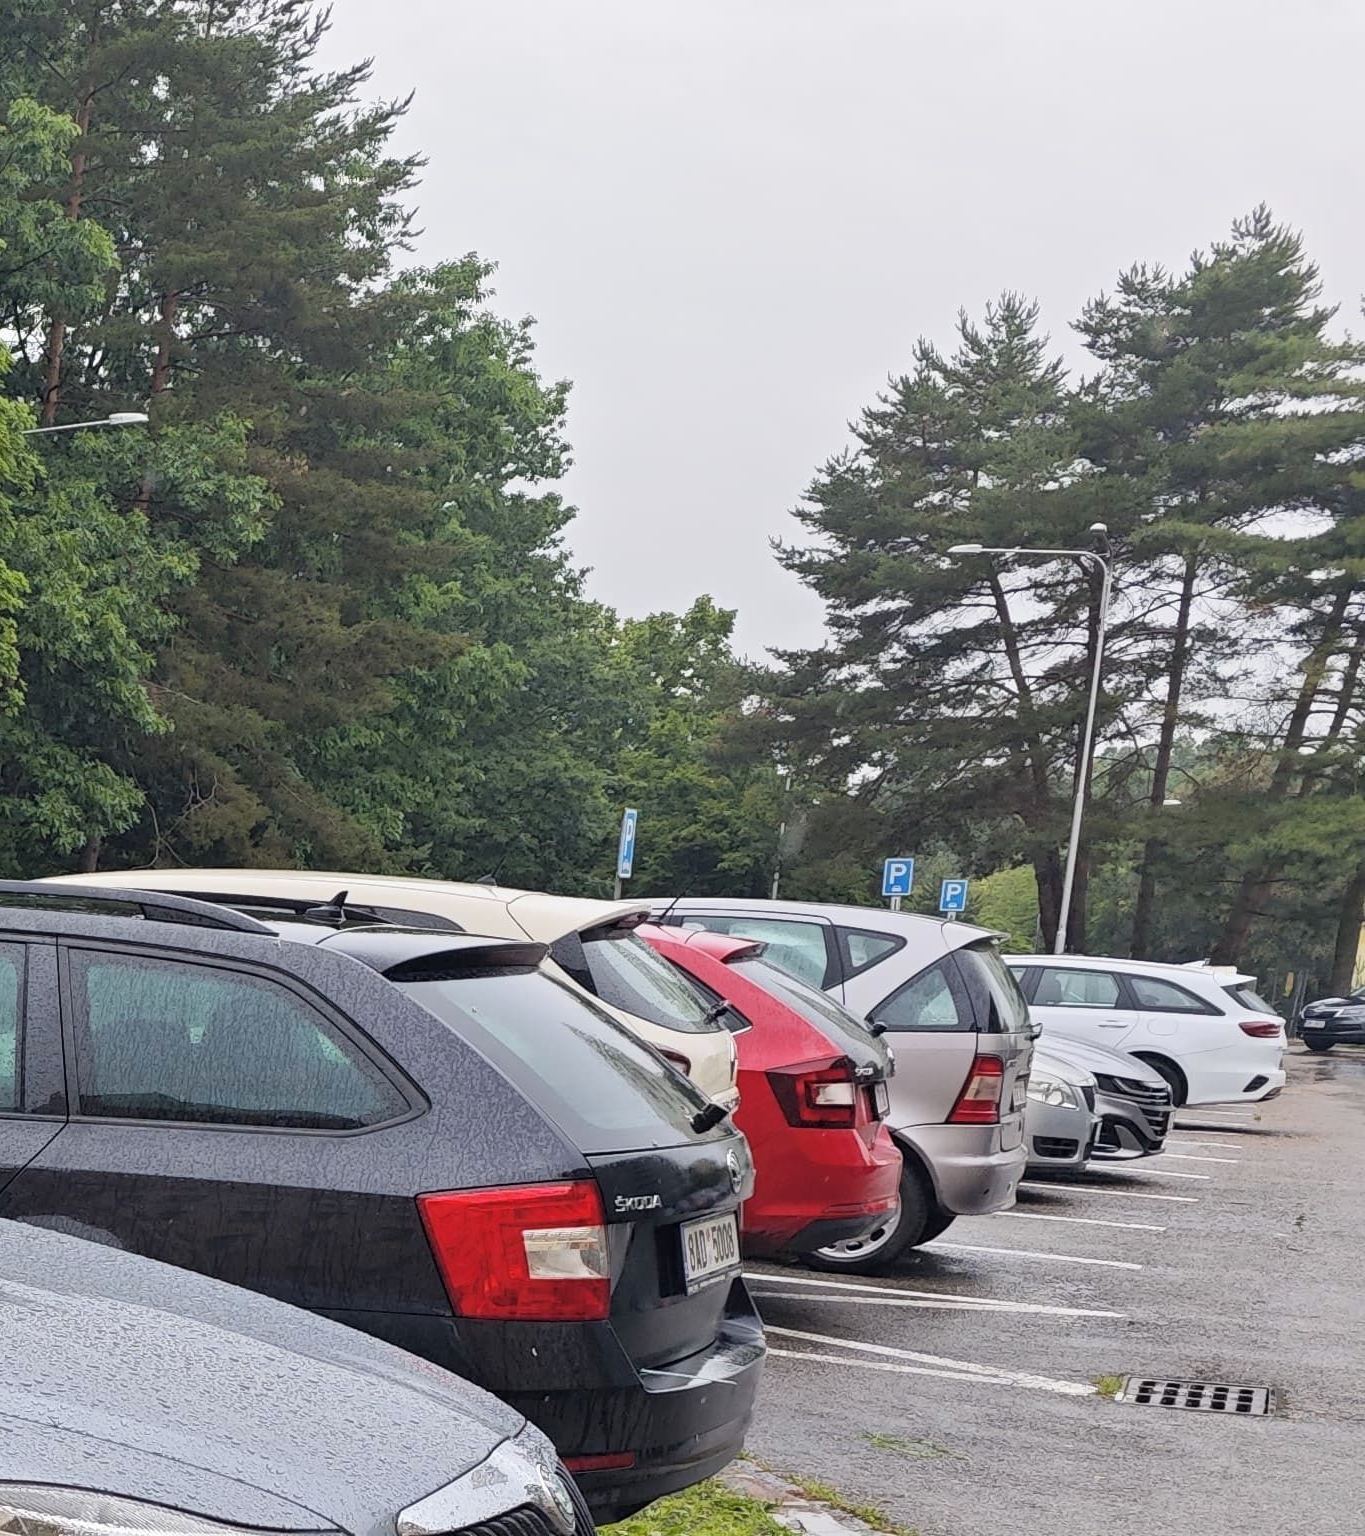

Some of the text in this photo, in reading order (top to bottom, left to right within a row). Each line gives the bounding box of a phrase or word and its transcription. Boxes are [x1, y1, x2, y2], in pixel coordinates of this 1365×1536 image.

[624, 819, 633, 857] P
[889, 863, 907, 885] P
[946, 884, 962, 902] P
[614, 1195, 662, 1212] ŠKODA
